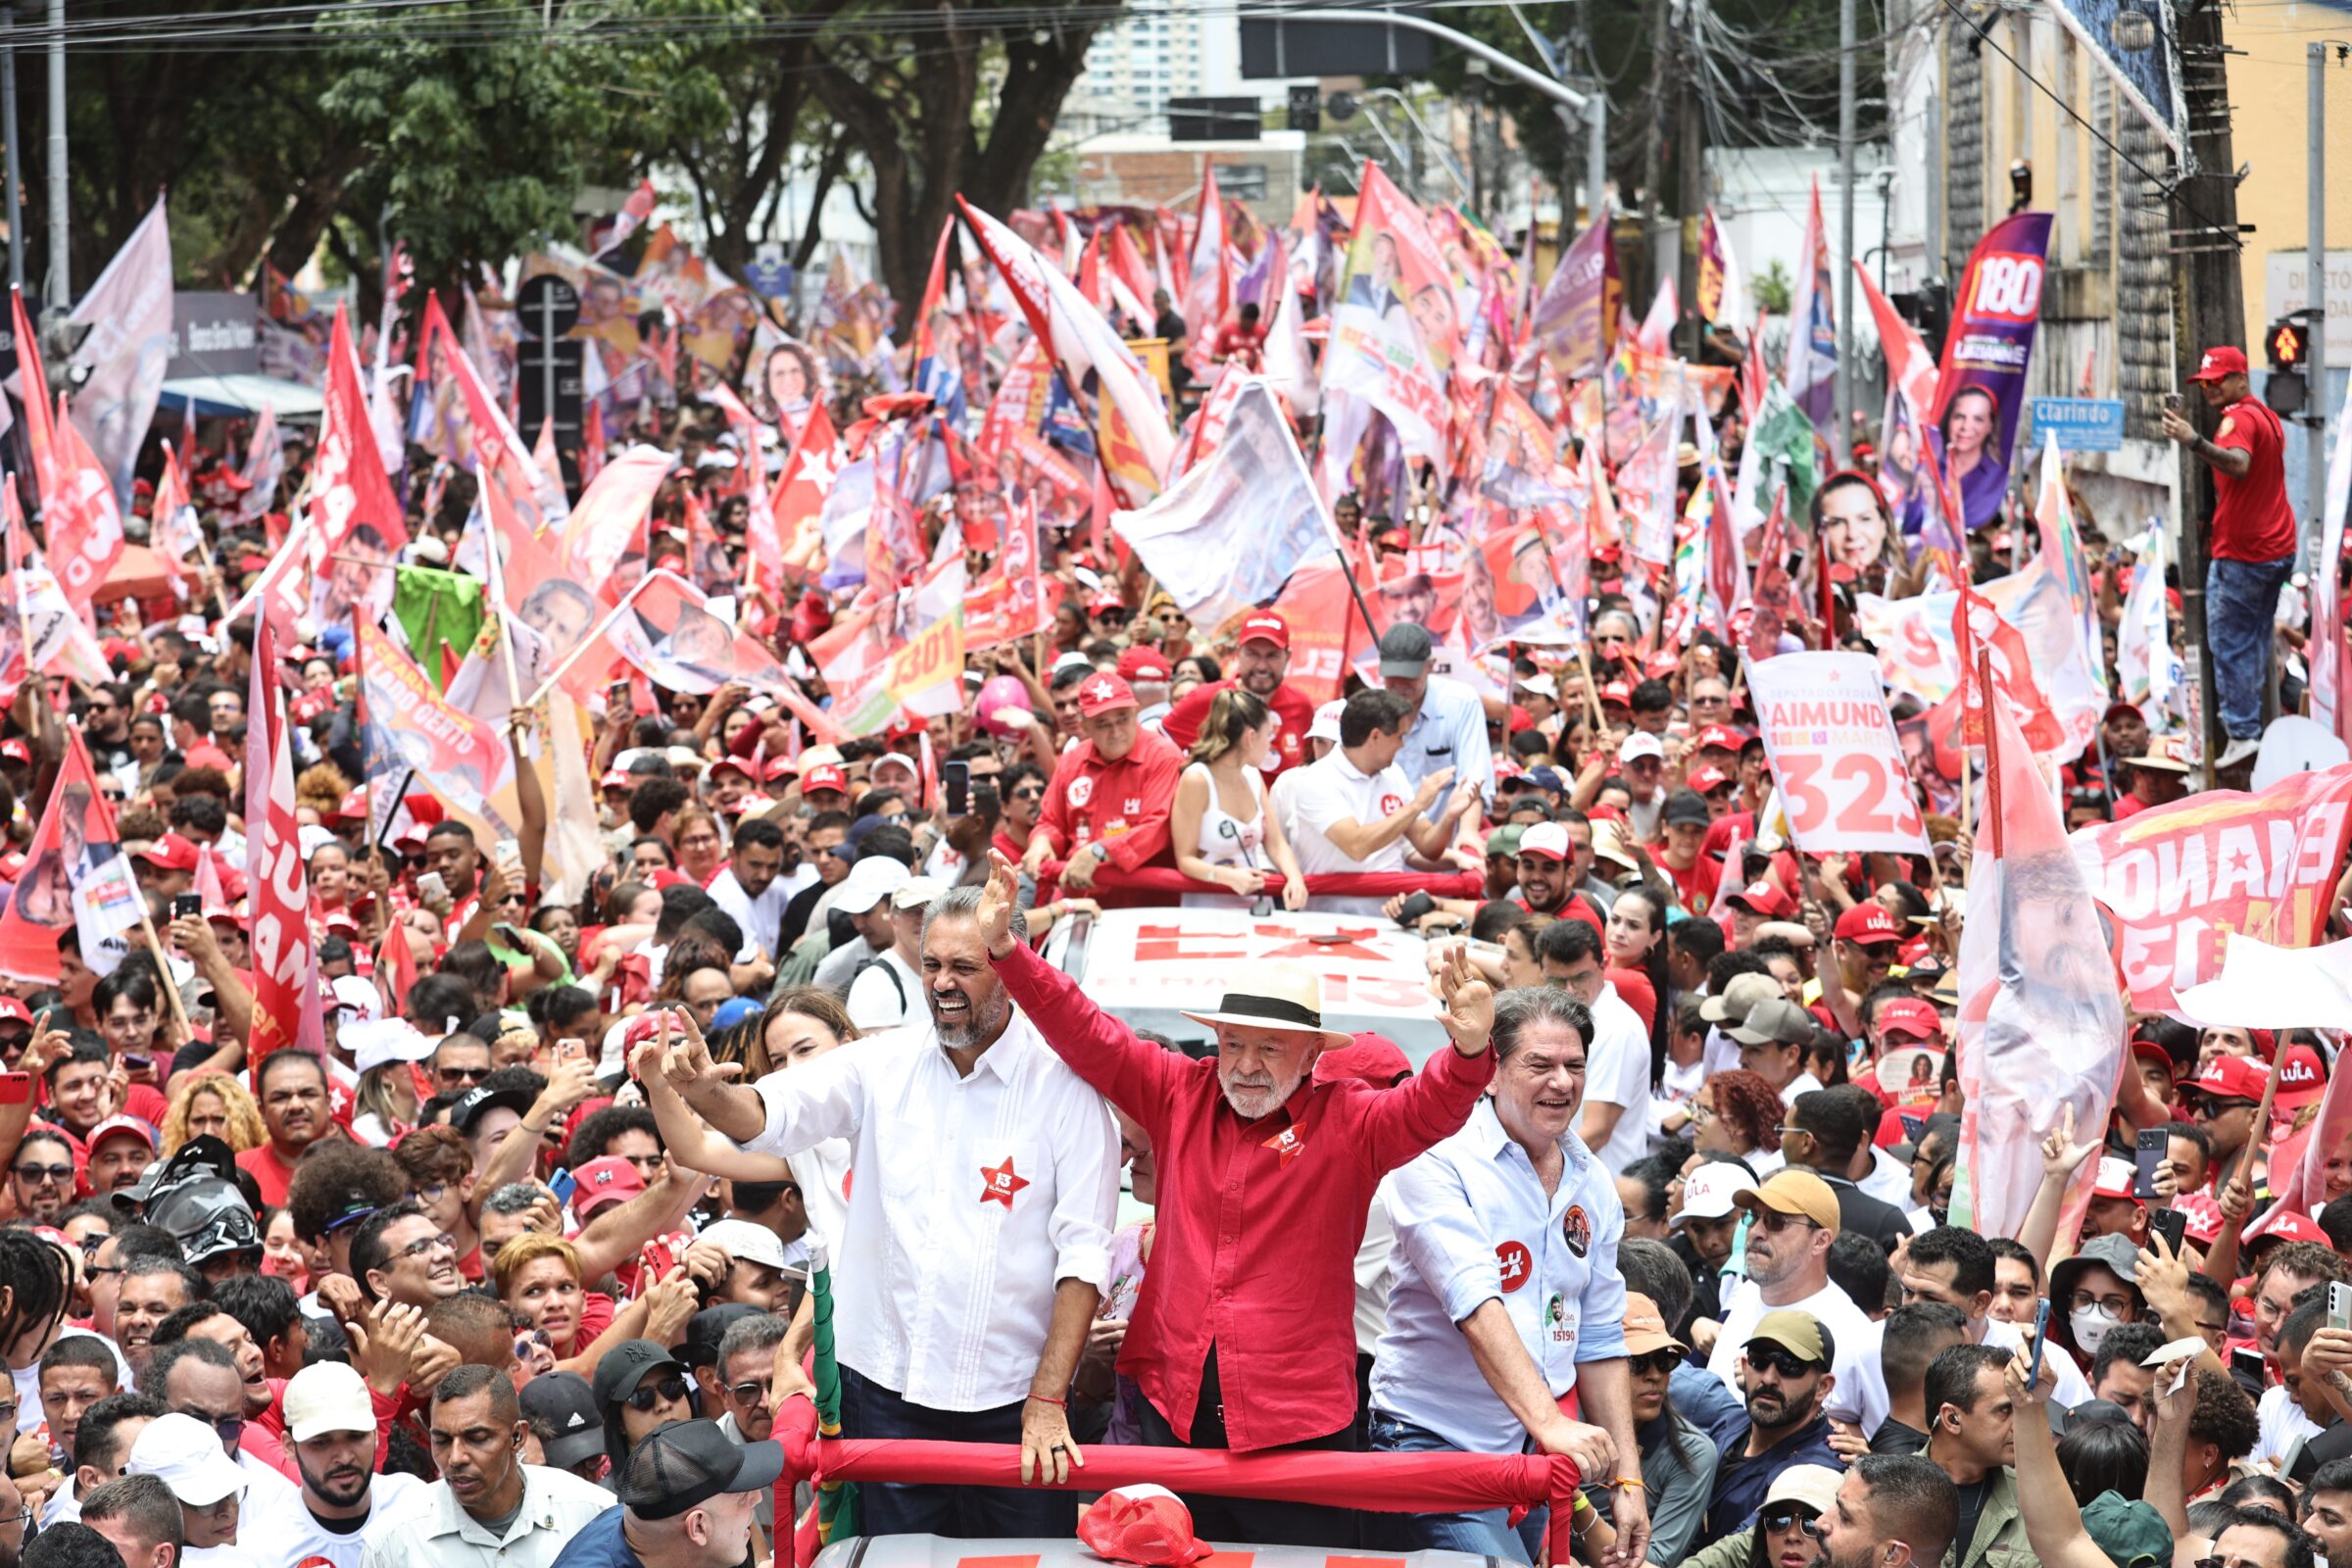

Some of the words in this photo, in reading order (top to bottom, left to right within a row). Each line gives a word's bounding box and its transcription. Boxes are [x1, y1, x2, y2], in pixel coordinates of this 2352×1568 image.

[1976, 256, 2042, 317] 180
[2036, 402, 2111, 423] Clarindo
[1761, 702, 1886, 729] AIMUND
[2280, 1066, 2315, 1082] LULA
[1278, 1130, 1296, 1145] 13
[994, 1172, 1009, 1187] 13
[988, 1184, 1011, 1196] ELMANO
[1552, 1330, 1576, 1342] 15190
